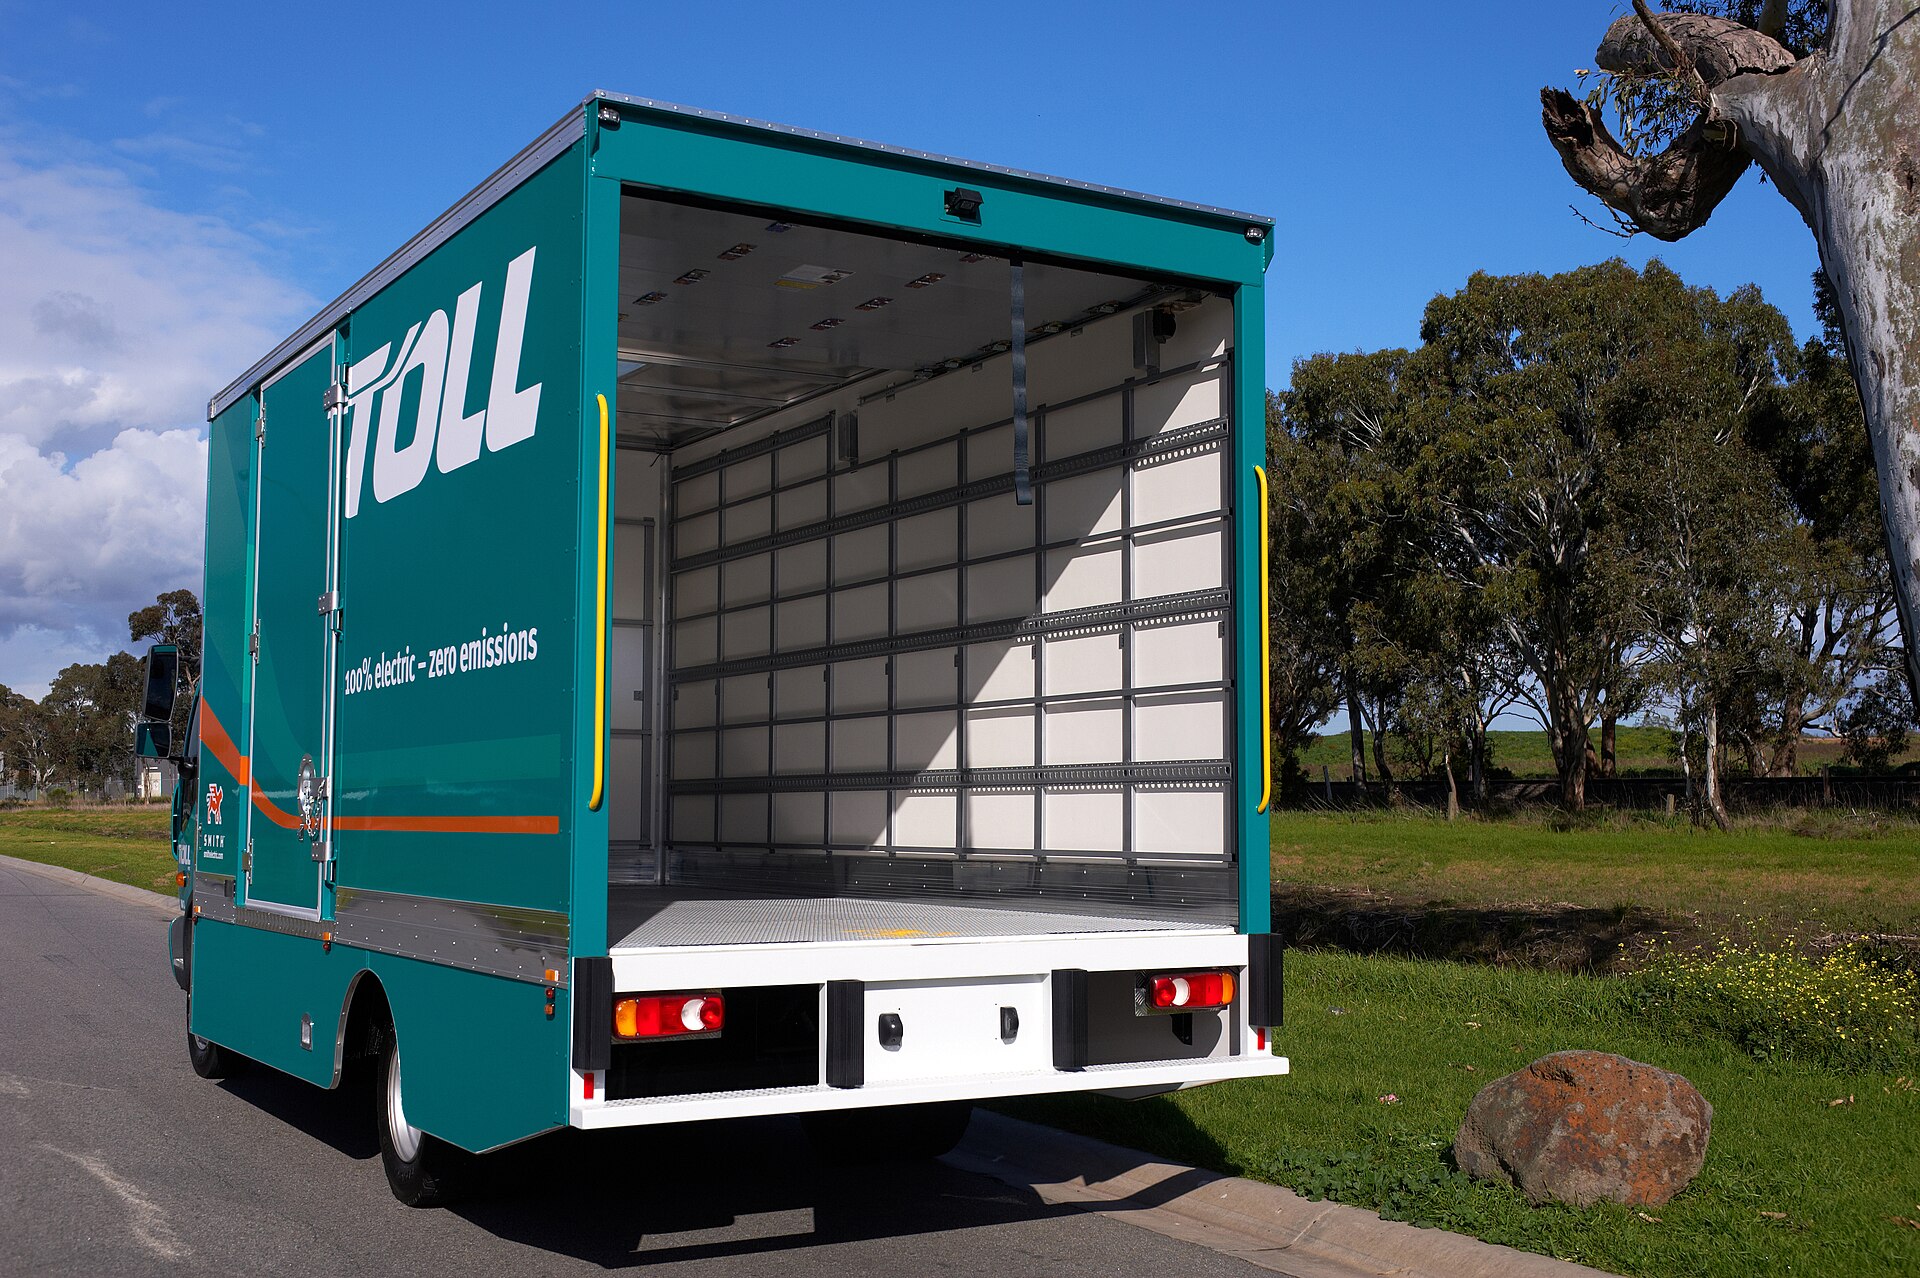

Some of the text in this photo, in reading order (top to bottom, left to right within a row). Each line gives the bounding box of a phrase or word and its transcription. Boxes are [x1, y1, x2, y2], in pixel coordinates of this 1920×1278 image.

[330, 245, 542, 519] TOLL
[345, 657, 373, 695] 100%
[375, 645, 416, 687] electric
[428, 645, 457, 679] zero
[459, 622, 538, 673] emissions
[203, 834, 225, 848] SMITH
